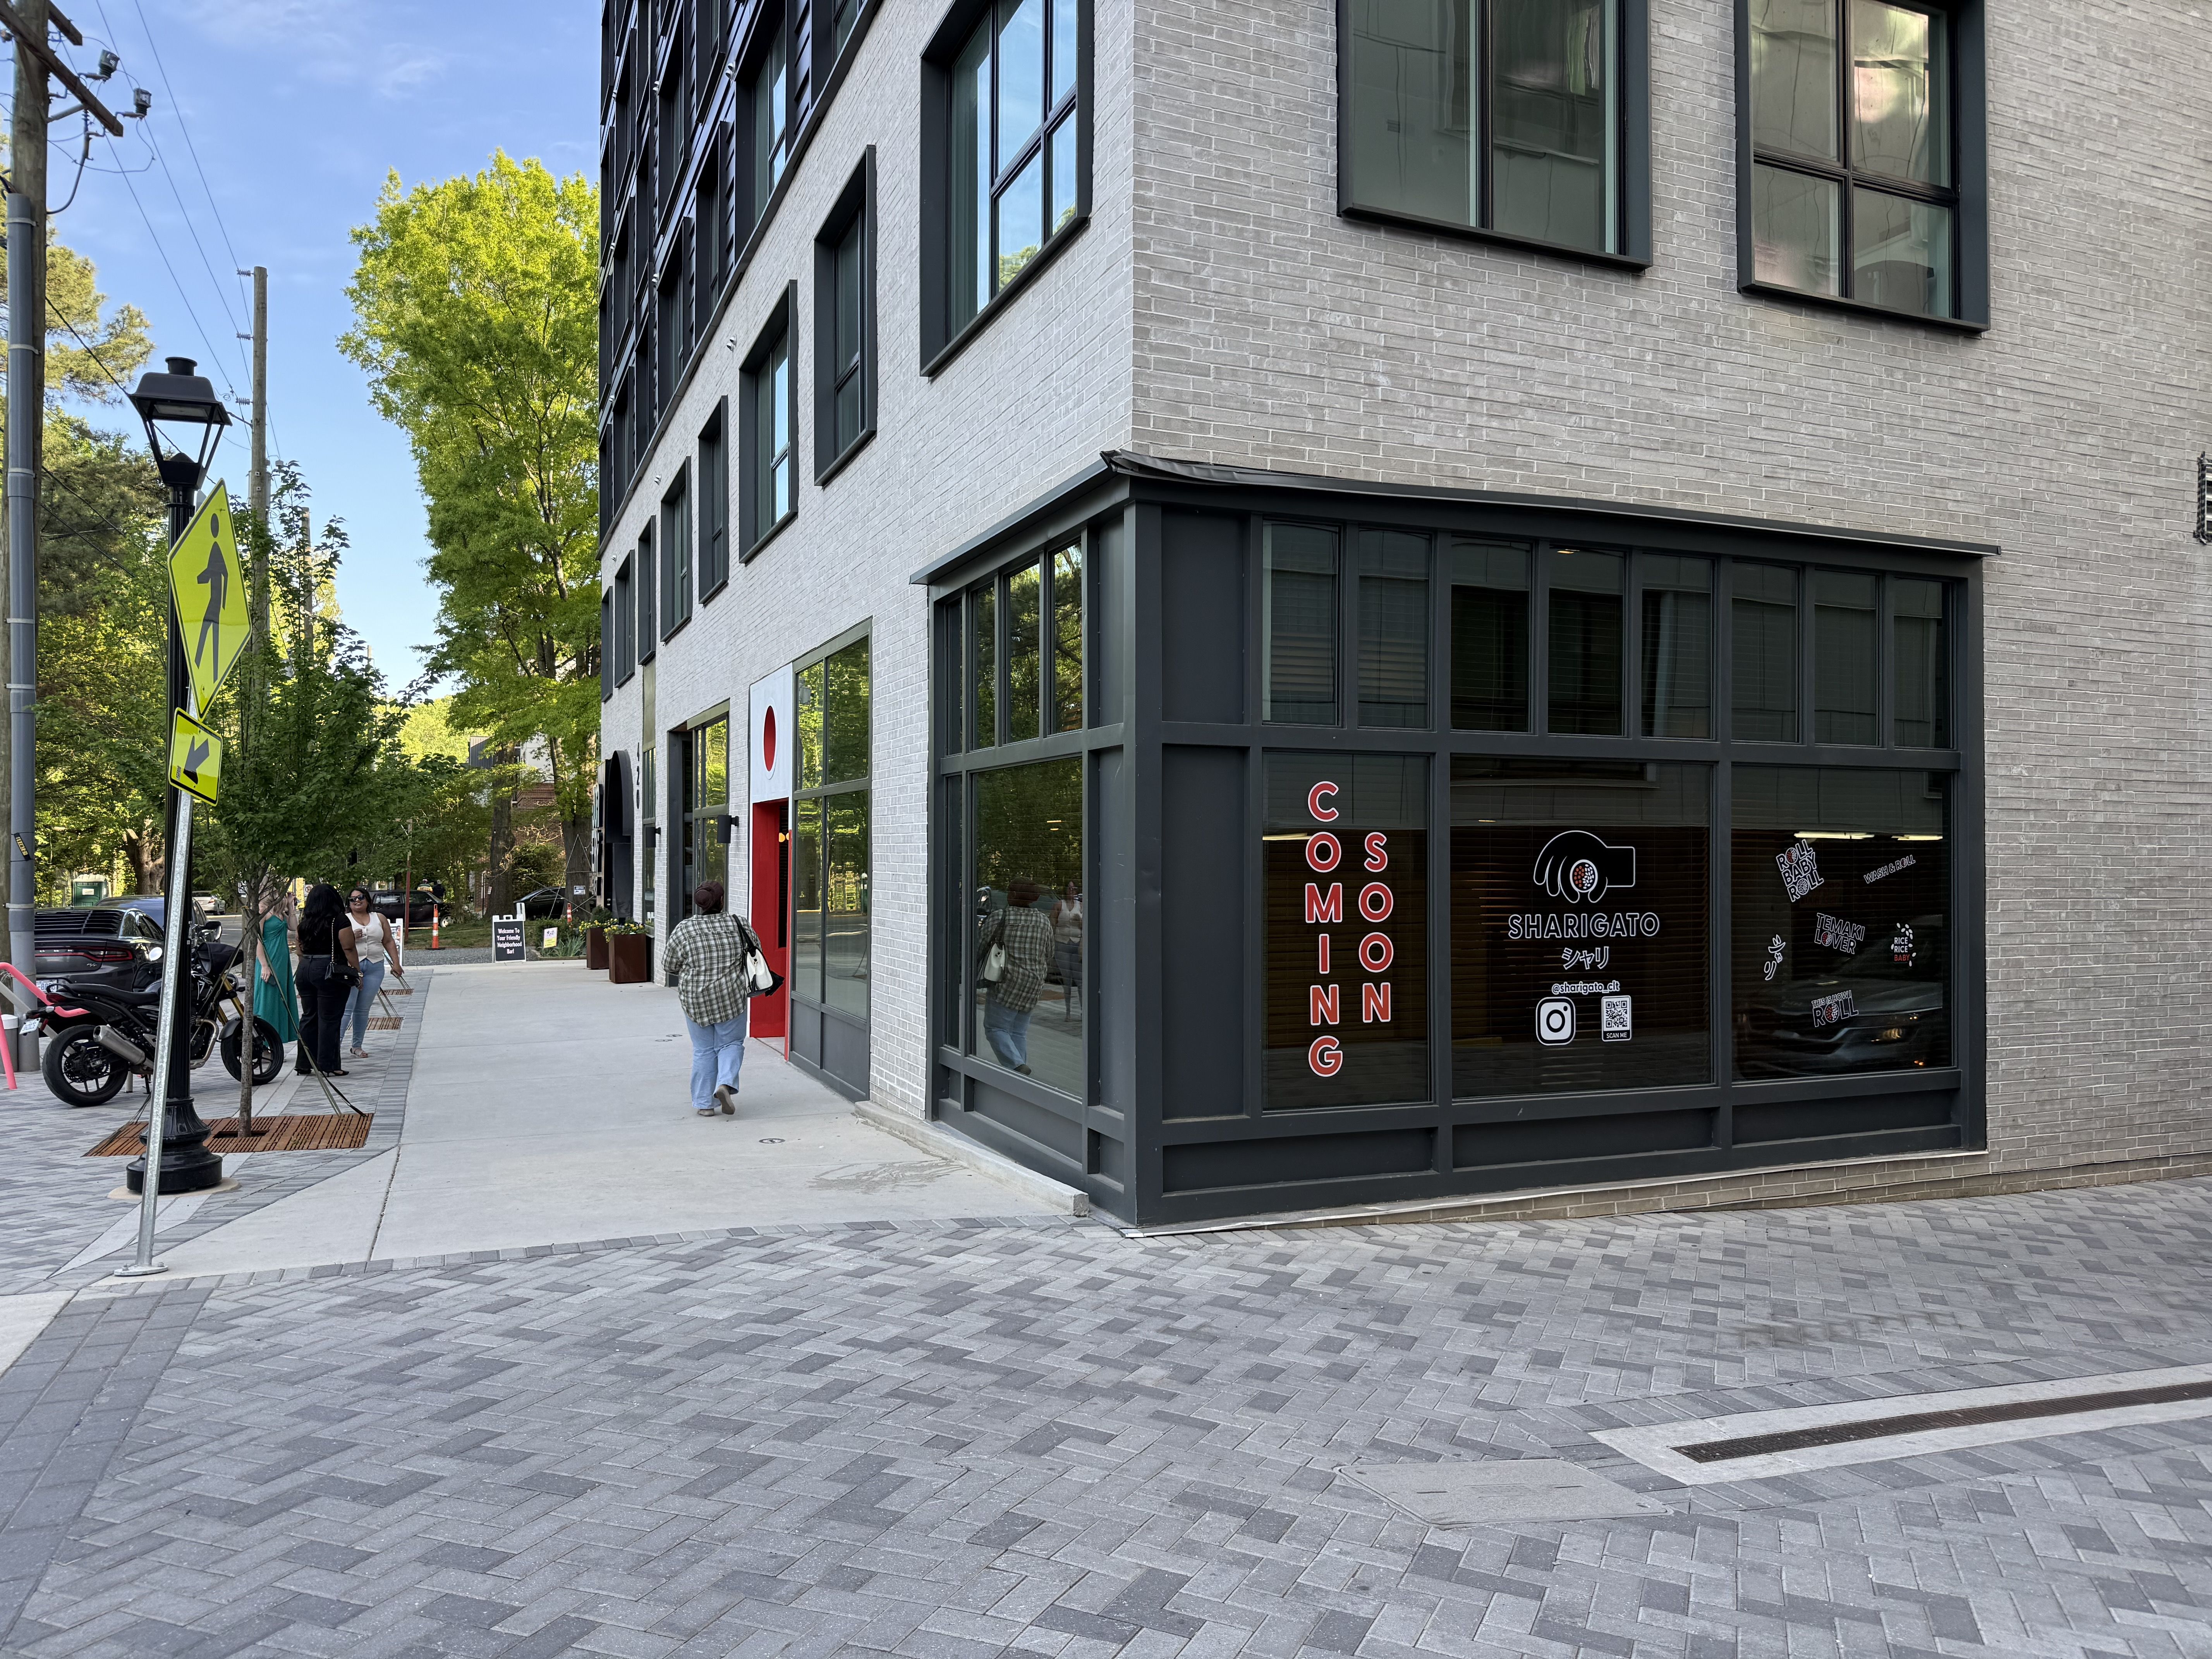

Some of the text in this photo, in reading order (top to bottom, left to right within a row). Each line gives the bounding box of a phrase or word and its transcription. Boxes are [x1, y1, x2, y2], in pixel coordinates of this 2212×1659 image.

[1776, 839, 1813, 871] ROLL
[1781, 852, 1817, 887] BABY
[1863, 855, 1916, 884] WASH & ROLL
[1787, 870, 1824, 902] ROLL
[1305, 781, 1343, 1077] COMING
[1358, 832, 1393, 1023] SOON
[1508, 912, 1660, 939] SHARIGATO
[1817, 912, 1865, 941] TEMAKI
[1814, 929, 1856, 954] LOVER
[1561, 946, 1609, 970] シャリ
[1552, 980, 1620, 995] @sharigato_clt
[1811, 997, 1826, 1008] THIS
[1826, 996, 1832, 1004] IS
[1832, 991, 1848, 1002] HOW
[1812, 997, 1859, 1027] ROLL
